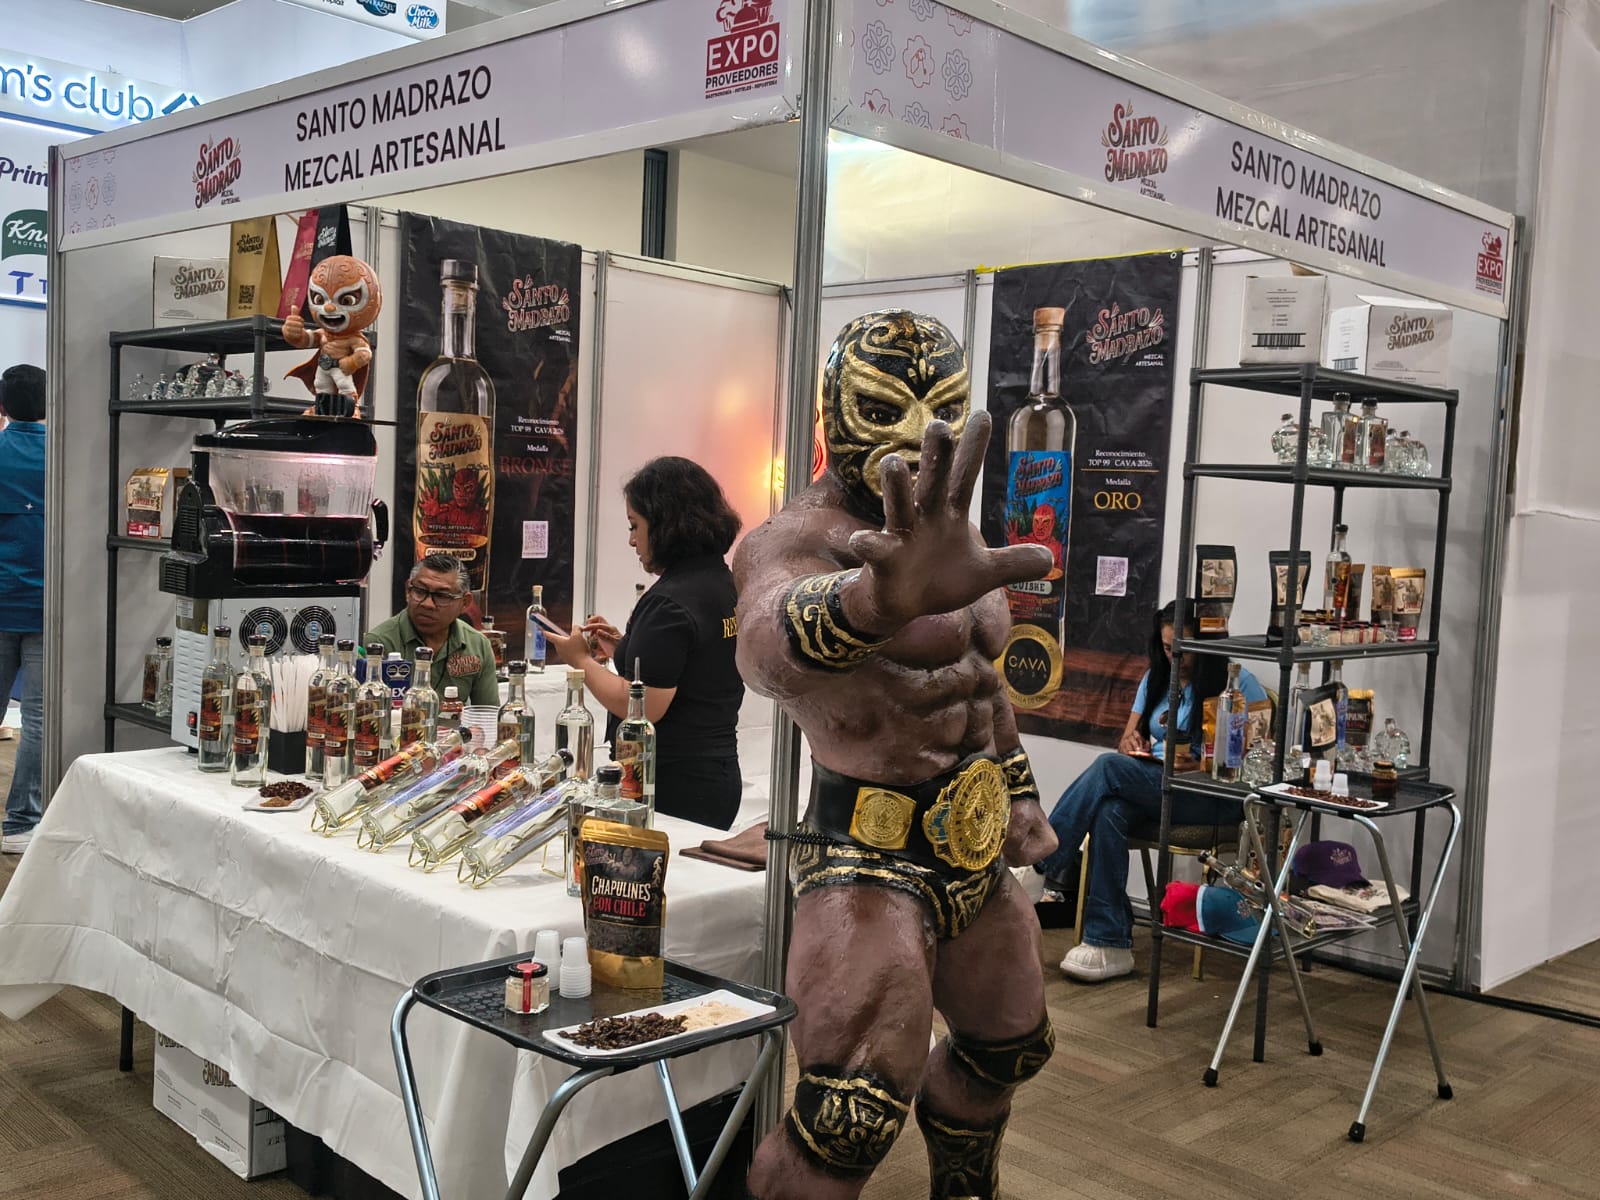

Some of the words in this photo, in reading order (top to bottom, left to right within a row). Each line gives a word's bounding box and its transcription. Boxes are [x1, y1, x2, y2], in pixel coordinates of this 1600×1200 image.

[408, 6, 435, 16] Choco
[412, 16, 431, 28] Milk
[708, 30, 777, 71] EXPO
[705, 63, 778, 89] PROVEEDORES
[64, 76, 154, 121] club
[297, 98, 365, 142] SANTO
[373, 65, 492, 124] MADRAZO
[1108, 103, 1160, 148] SANTO
[196, 137, 233, 179] SANTO
[285, 149, 364, 192] MEZCAL
[370, 117, 506, 176] ARTESANAL
[1105, 147, 1168, 183] MADRAZO
[195, 157, 241, 209] MADRAZO
[1231, 142, 1296, 191] SANTO
[1299, 167, 1382, 221] MADRAZO
[1216, 187, 1291, 238] MEZCAL
[1295, 212, 1386, 268] ARTESANAL
[174, 266, 216, 285] SANTO
[1477, 256, 1502, 279] EXPO
[174, 280, 226, 299] MADRAZO
[508, 278, 559, 308] SANTO
[507, 304, 570, 332] MADRAZO
[1092, 307, 1151, 340] SANTO
[1389, 315, 1427, 334] SANTO
[1089, 325, 1164, 364] MADRAZO
[1387, 329, 1435, 351] MADRAZO
[430, 422, 475, 442] SANTO
[517, 416, 560, 426] Reconocimiento
[534, 426, 552, 434] CAVA
[429, 437, 482, 460] MADRAZO
[1095, 449, 1146, 457] Reconocimiento
[499, 455, 572, 476] BRONCE
[1114, 459, 1136, 467] CAVA
[1094, 491, 1142, 511] ORO
[1008, 655, 1047, 672] CAVA
[591, 875, 651, 902] CHAPULINES
[593, 896, 612, 912] CON
[613, 899, 646, 917] CHILE
